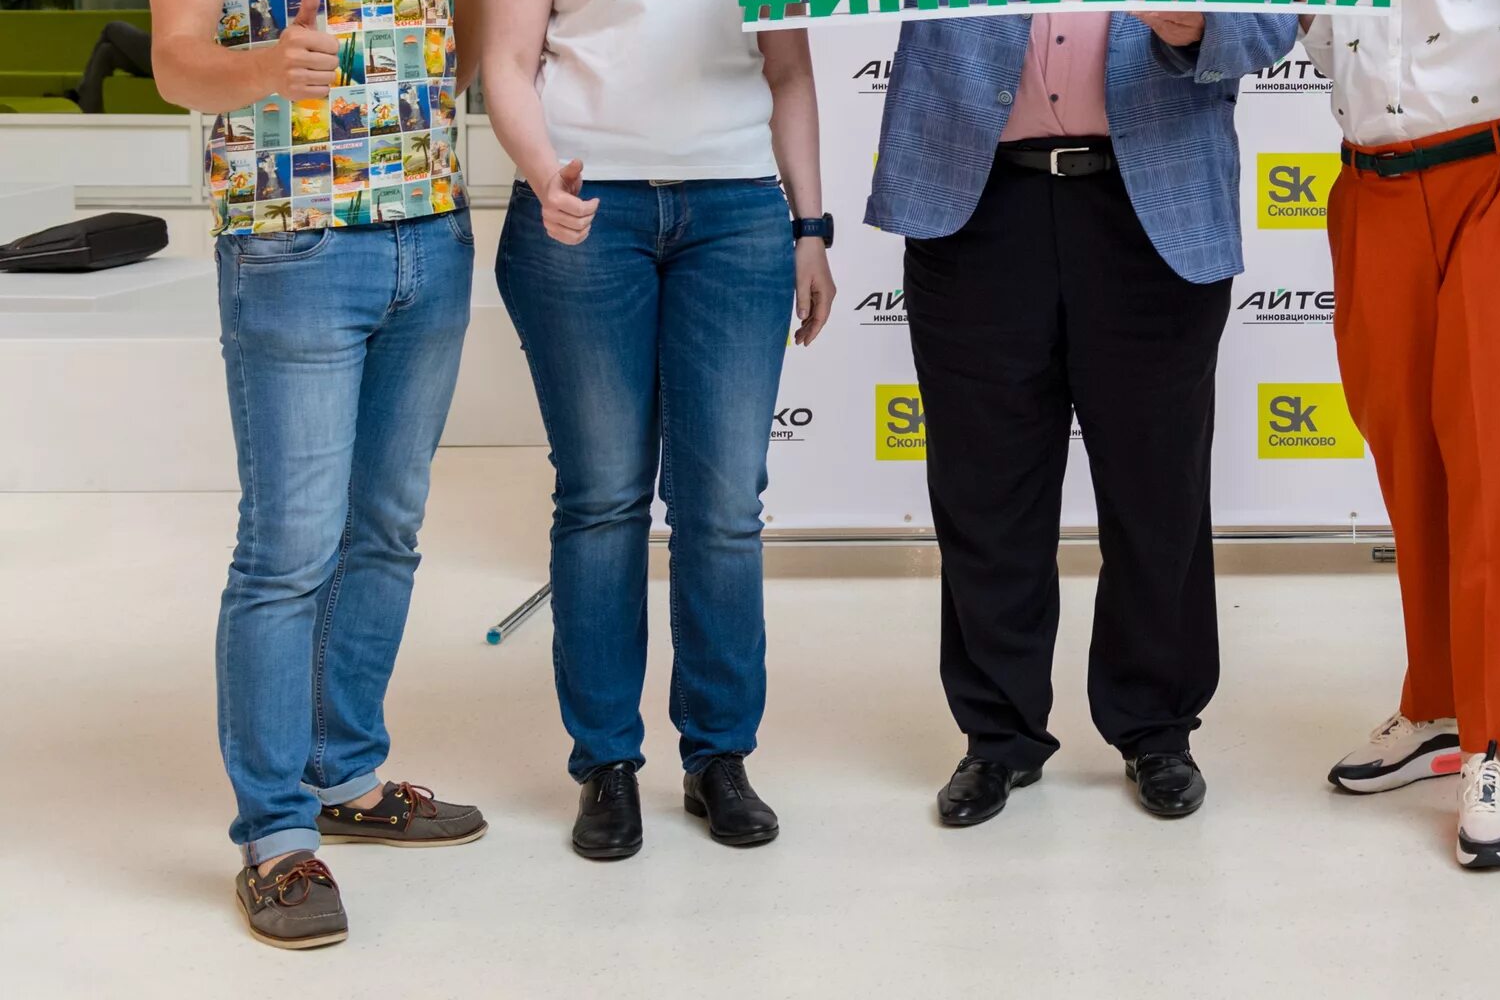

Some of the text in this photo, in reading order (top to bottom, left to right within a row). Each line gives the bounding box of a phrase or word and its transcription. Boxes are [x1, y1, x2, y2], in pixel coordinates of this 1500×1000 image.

[1255, 82, 1333, 91] инновационный
[1268, 165, 1317, 203] Sk
[1267, 204, 1327, 217] Сколков
[1256, 312, 1334, 322] инновационный
[886, 396, 926, 435] Sk
[1269, 395, 1318, 433] Sk
[770, 431, 793, 440] ентр
[1268, 434, 1337, 447] Сколково
